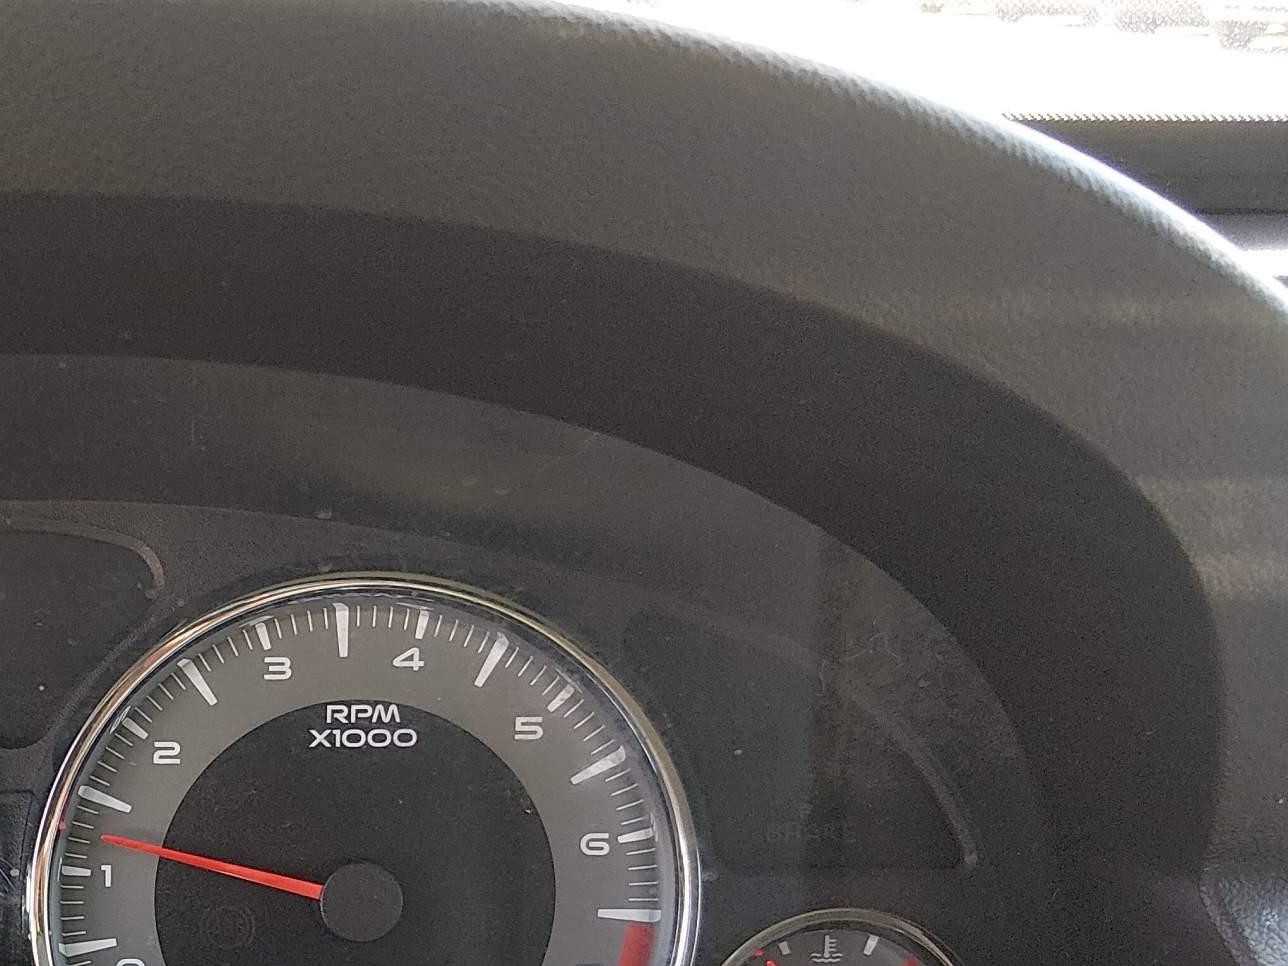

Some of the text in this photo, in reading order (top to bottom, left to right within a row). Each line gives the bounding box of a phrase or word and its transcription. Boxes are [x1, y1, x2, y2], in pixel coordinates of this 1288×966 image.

[264, 657, 291, 679] 3
[393, 648, 424, 670] 4
[327, 704, 400, 723] RPM
[309, 729, 417, 747] X1000
[515, 717, 543, 739] 5
[153, 742, 180, 764] 2
[581, 833, 609, 855] 6
[101, 865, 111, 887] 1
